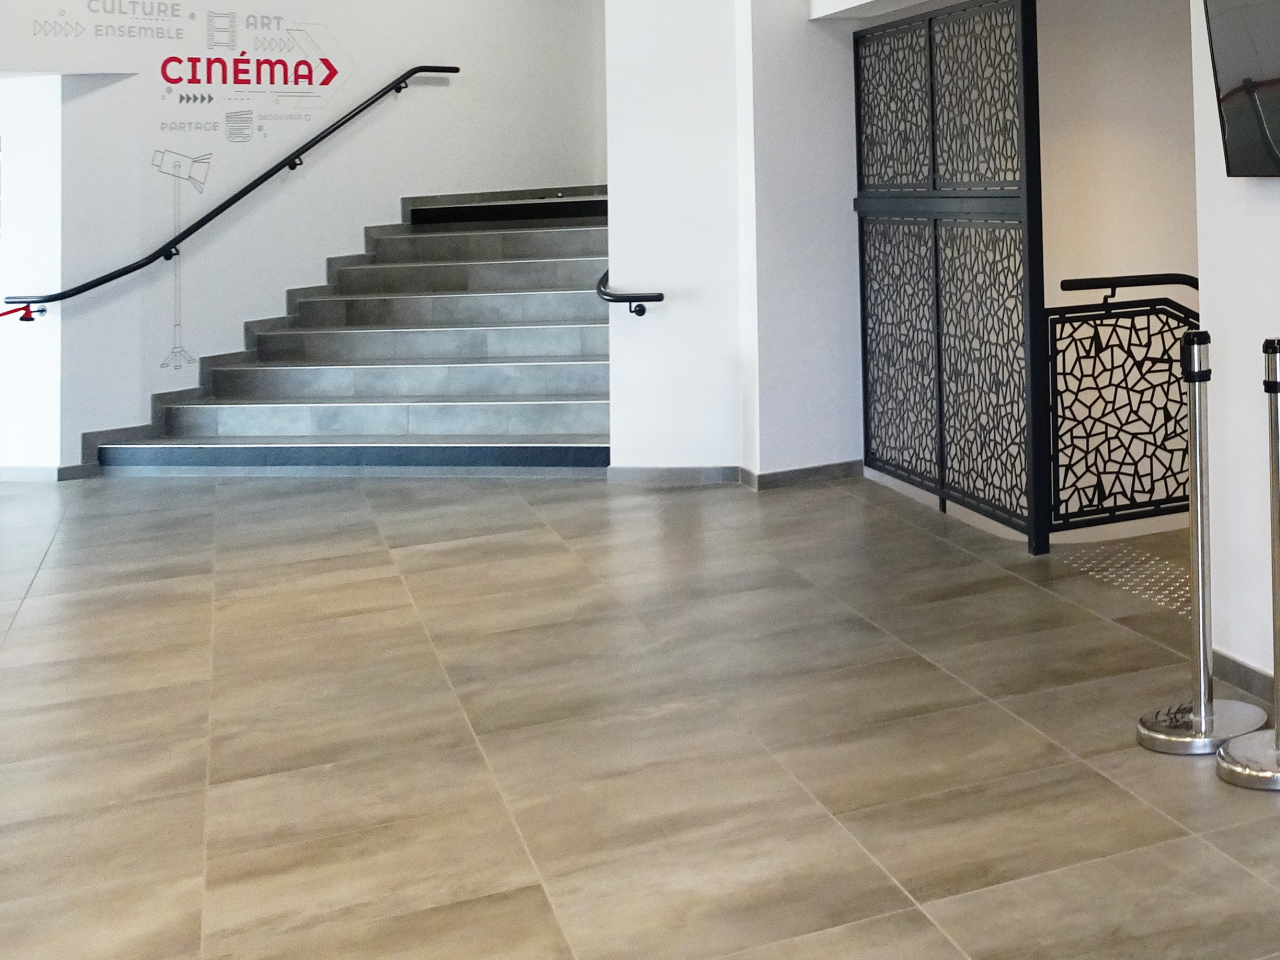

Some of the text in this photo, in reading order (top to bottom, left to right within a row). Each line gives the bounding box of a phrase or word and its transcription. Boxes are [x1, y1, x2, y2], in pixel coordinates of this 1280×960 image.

[245, 14, 285, 32] ART
[94, 24, 184, 40] ENSEMBLE
[161, 51, 314, 86] CINÉMA
[160, 121, 219, 132] PARTAGE
